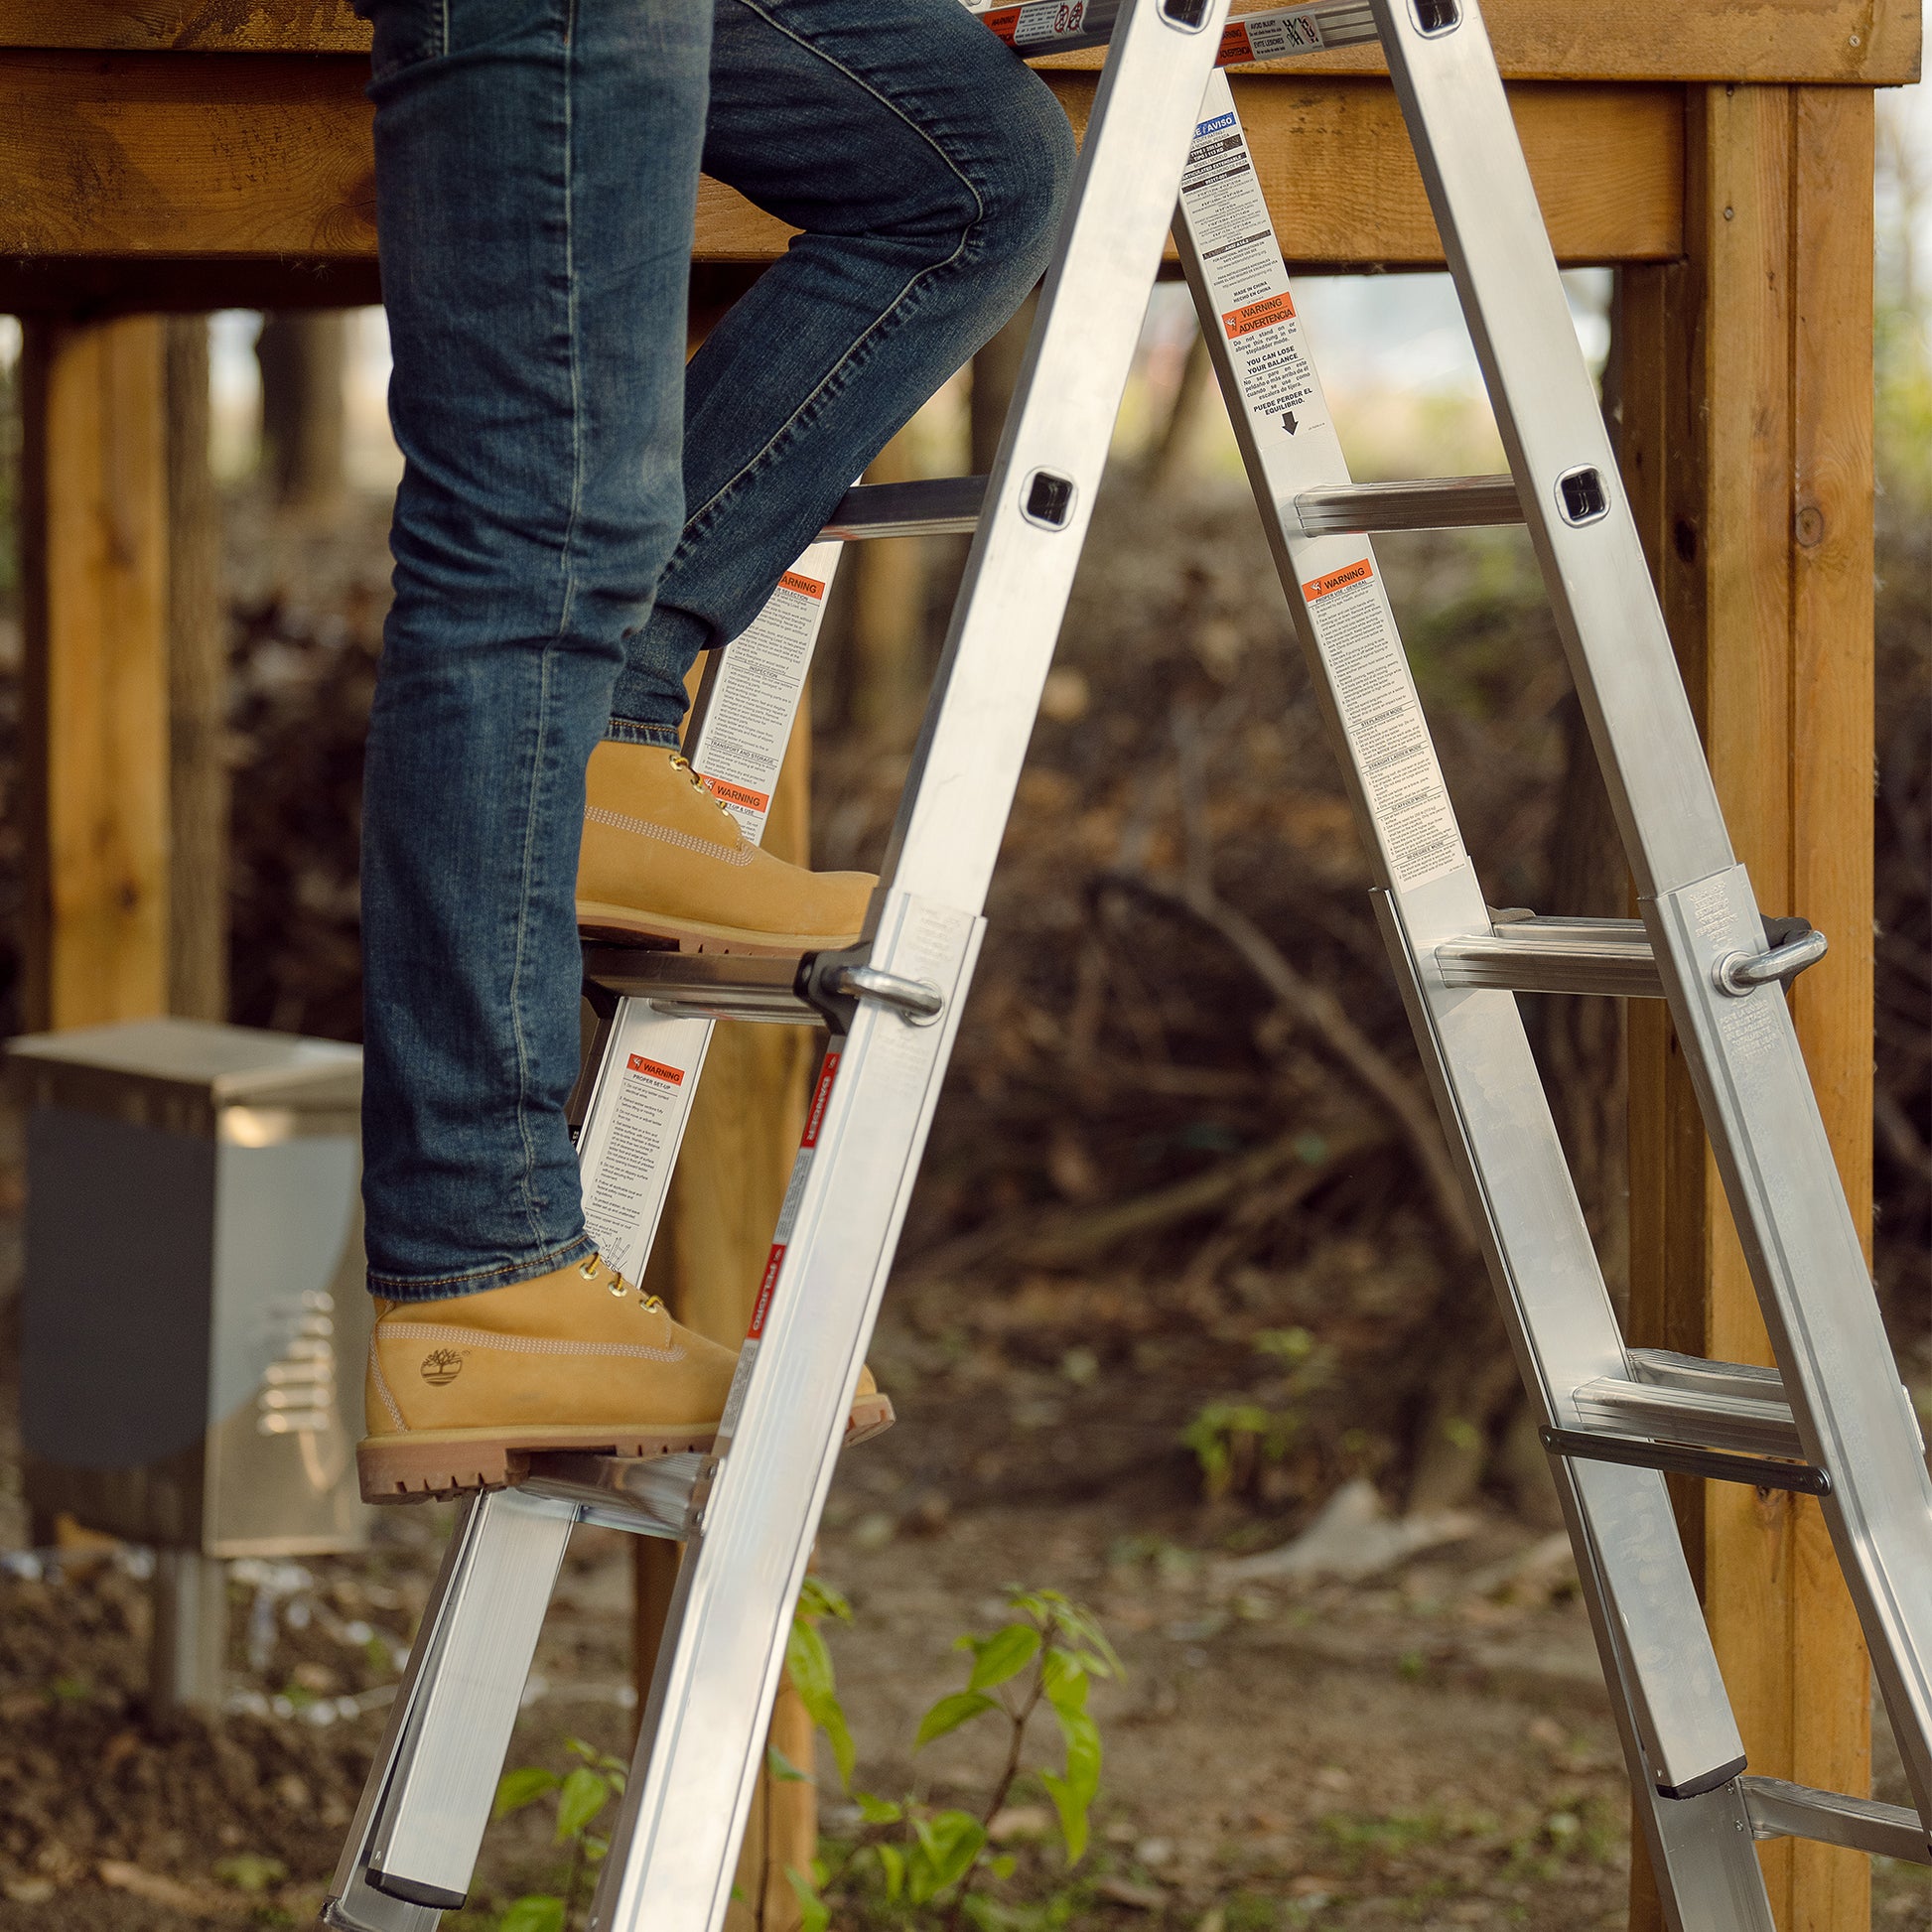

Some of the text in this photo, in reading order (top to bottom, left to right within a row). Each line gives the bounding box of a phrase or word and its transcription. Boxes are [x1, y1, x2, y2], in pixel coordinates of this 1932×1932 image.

[1220, 28, 1242, 40] ARNING
[1205, 115, 1232, 132] AVISO
[1232, 287, 1247, 297] MADE
[1252, 280, 1267, 289] CHINA
[1232, 293, 1250, 303] HECHO
[1256, 285, 1272, 295] CHINA
[1240, 297, 1283, 320] WARNING
[1237, 307, 1293, 335] ADVERTENCIA
[1232, 339, 1242, 347] Do
[1258, 328, 1274, 338] stand
[1234, 343, 1251, 353] above
[1252, 338, 1264, 346] this
[1265, 333, 1279, 343] rung
[1245, 335, 1290, 356] stepladder mode.
[1246, 345, 1295, 367] YOU CAN LOSE
[1247, 351, 1298, 375] YOUR BALANCE
[1295, 358, 1307, 367] este
[1246, 386, 1266, 398] cuando
[1295, 370, 1311, 380] como
[1252, 386, 1312, 413] PUEDE PERDER EL
[1258, 388, 1280, 401] escalera
[1264, 395, 1305, 416] EQUILIBRIO.
[779, 574, 817, 594] ARNING
[1323, 566, 1365, 590] WARNING
[780, 588, 808, 602] SELECTION
[749, 665, 778, 678] INSPECTION
[710, 740, 740, 754] TRANSPORT
[751, 753, 773, 764] STORAGE
[715, 784, 760, 807] WARNING
[631, 1073, 671, 1090] PROPER SET-UP
[642, 1062, 680, 1082] WARNING
[804, 1075, 832, 1140] DANGER
[750, 1263, 778, 1330] PELIGRO
